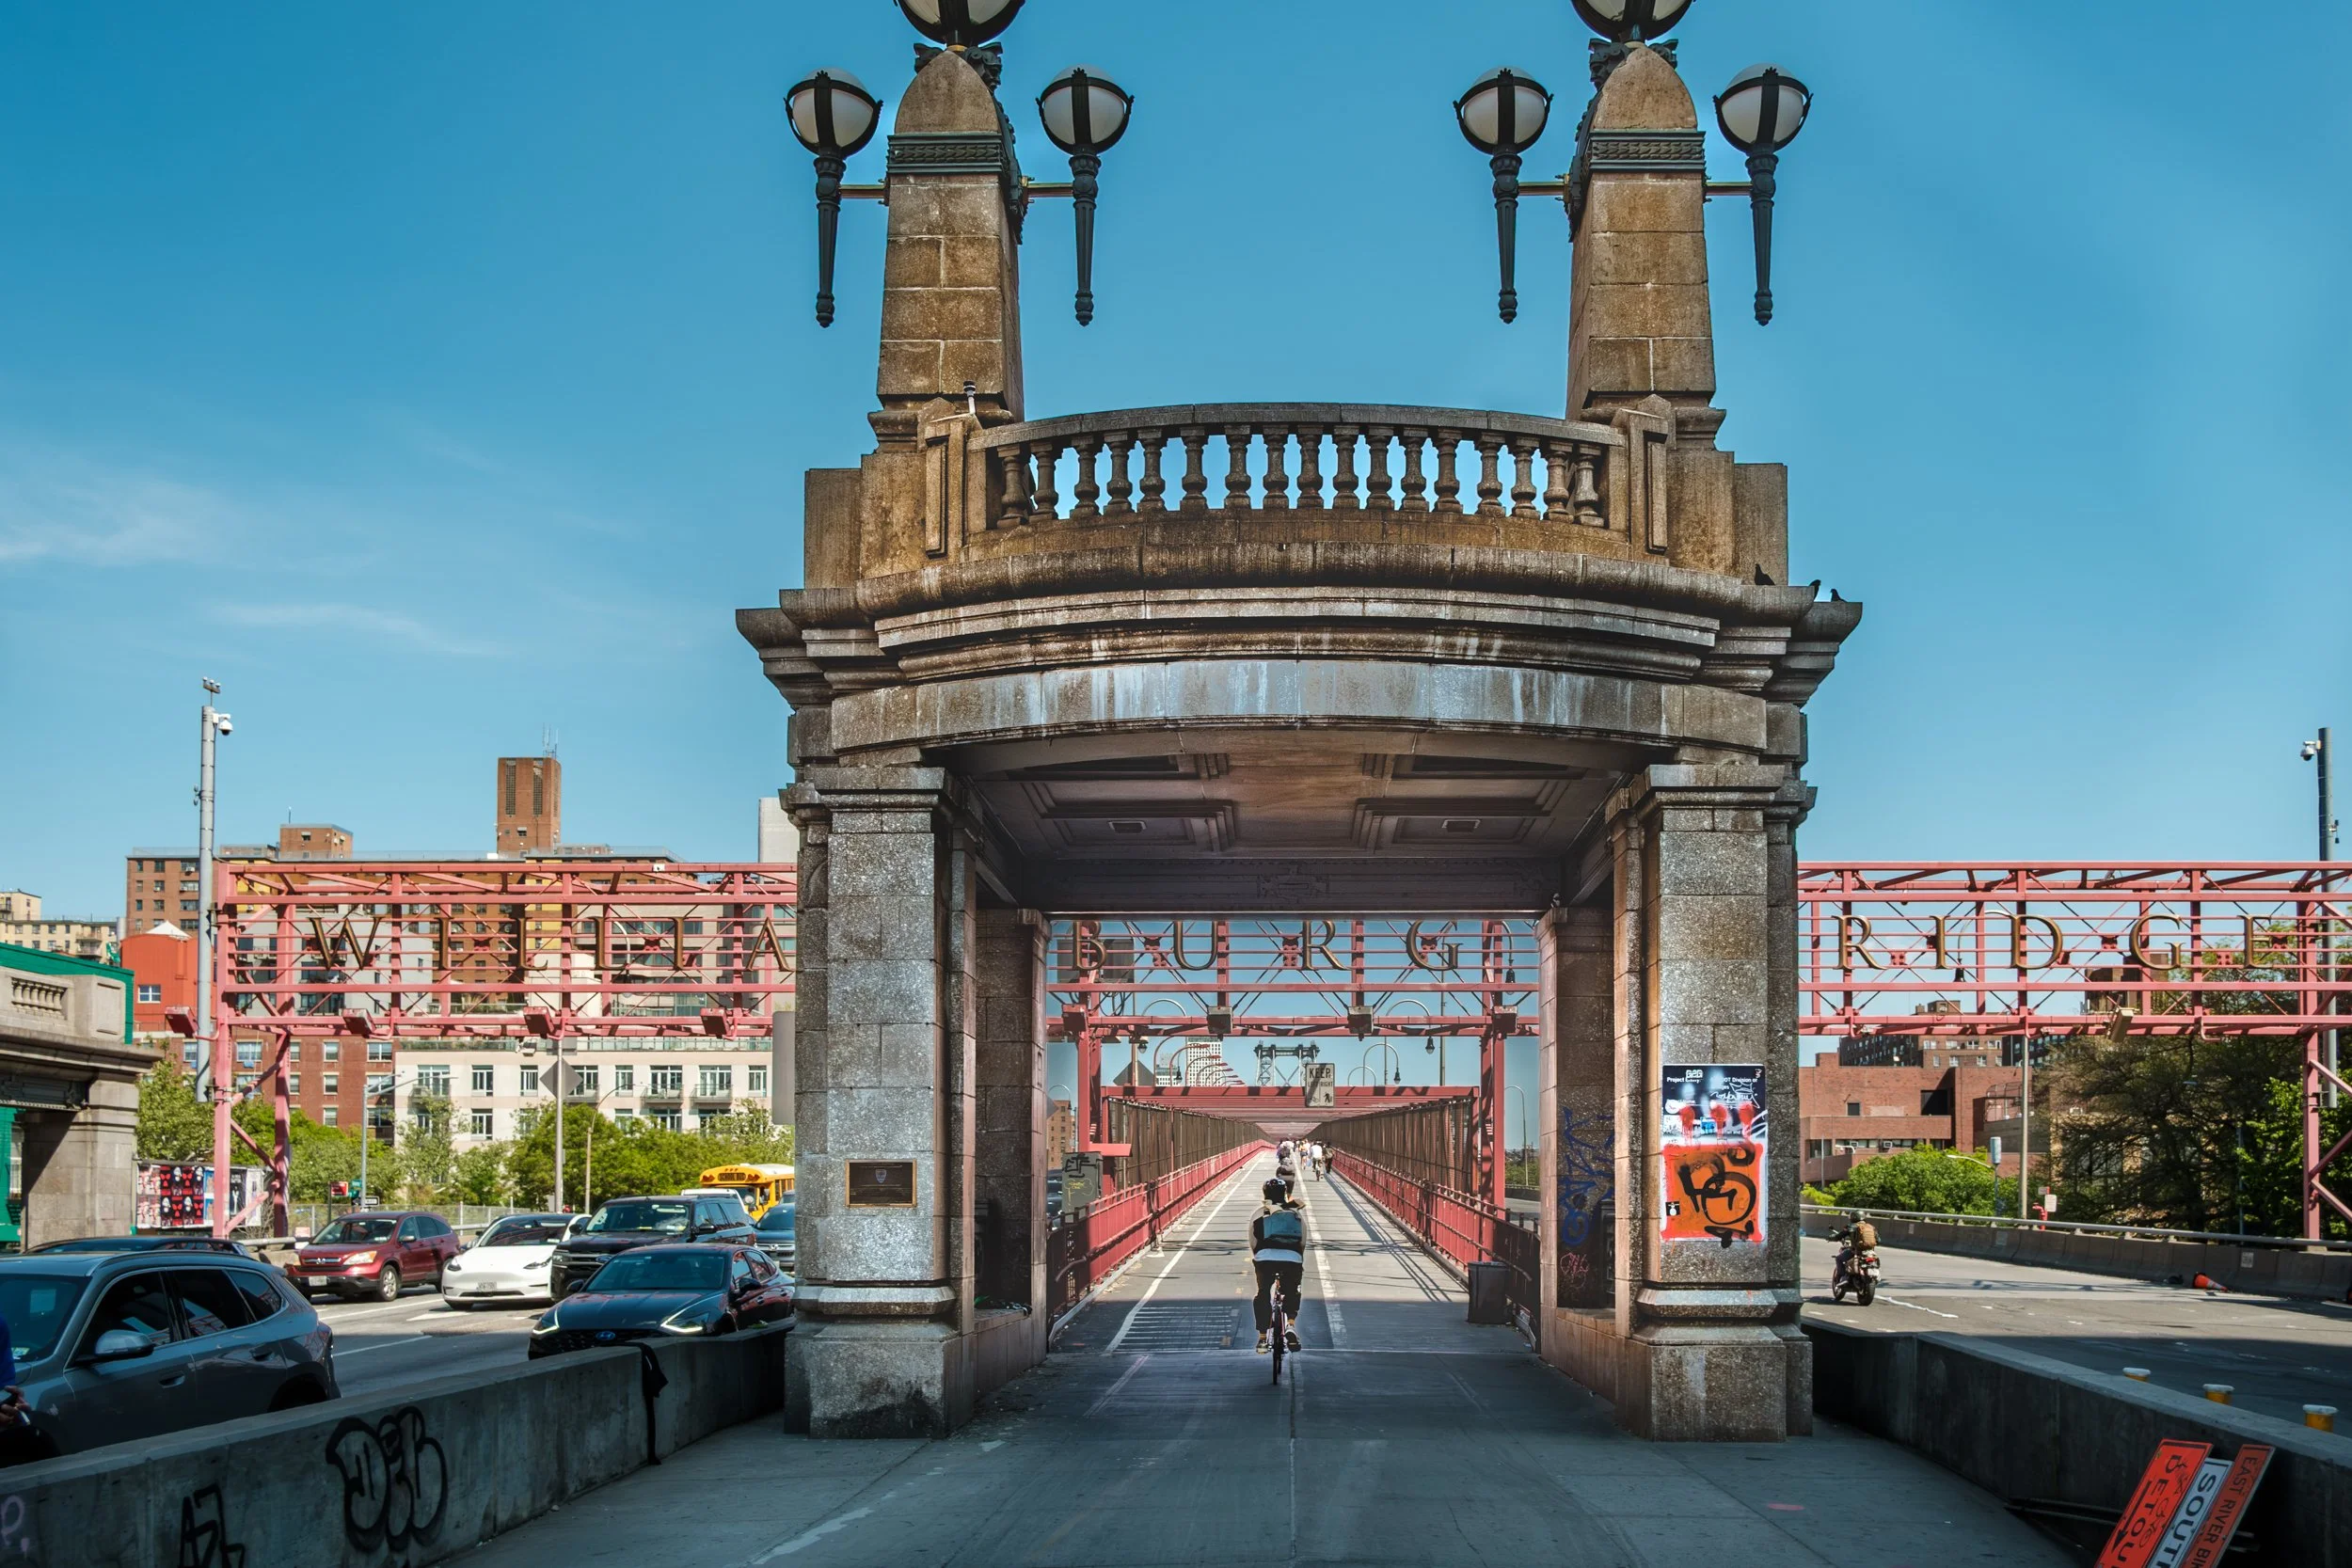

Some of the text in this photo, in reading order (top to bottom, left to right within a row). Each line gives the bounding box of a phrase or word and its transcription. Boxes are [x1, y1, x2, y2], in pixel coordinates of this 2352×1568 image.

[1309, 1068, 1331, 1079] KEEP
[2232, 1457, 2258, 1495] EAST
[2110, 1454, 2183, 1568] DETOU
[2205, 1499, 2236, 1544] RIVER
